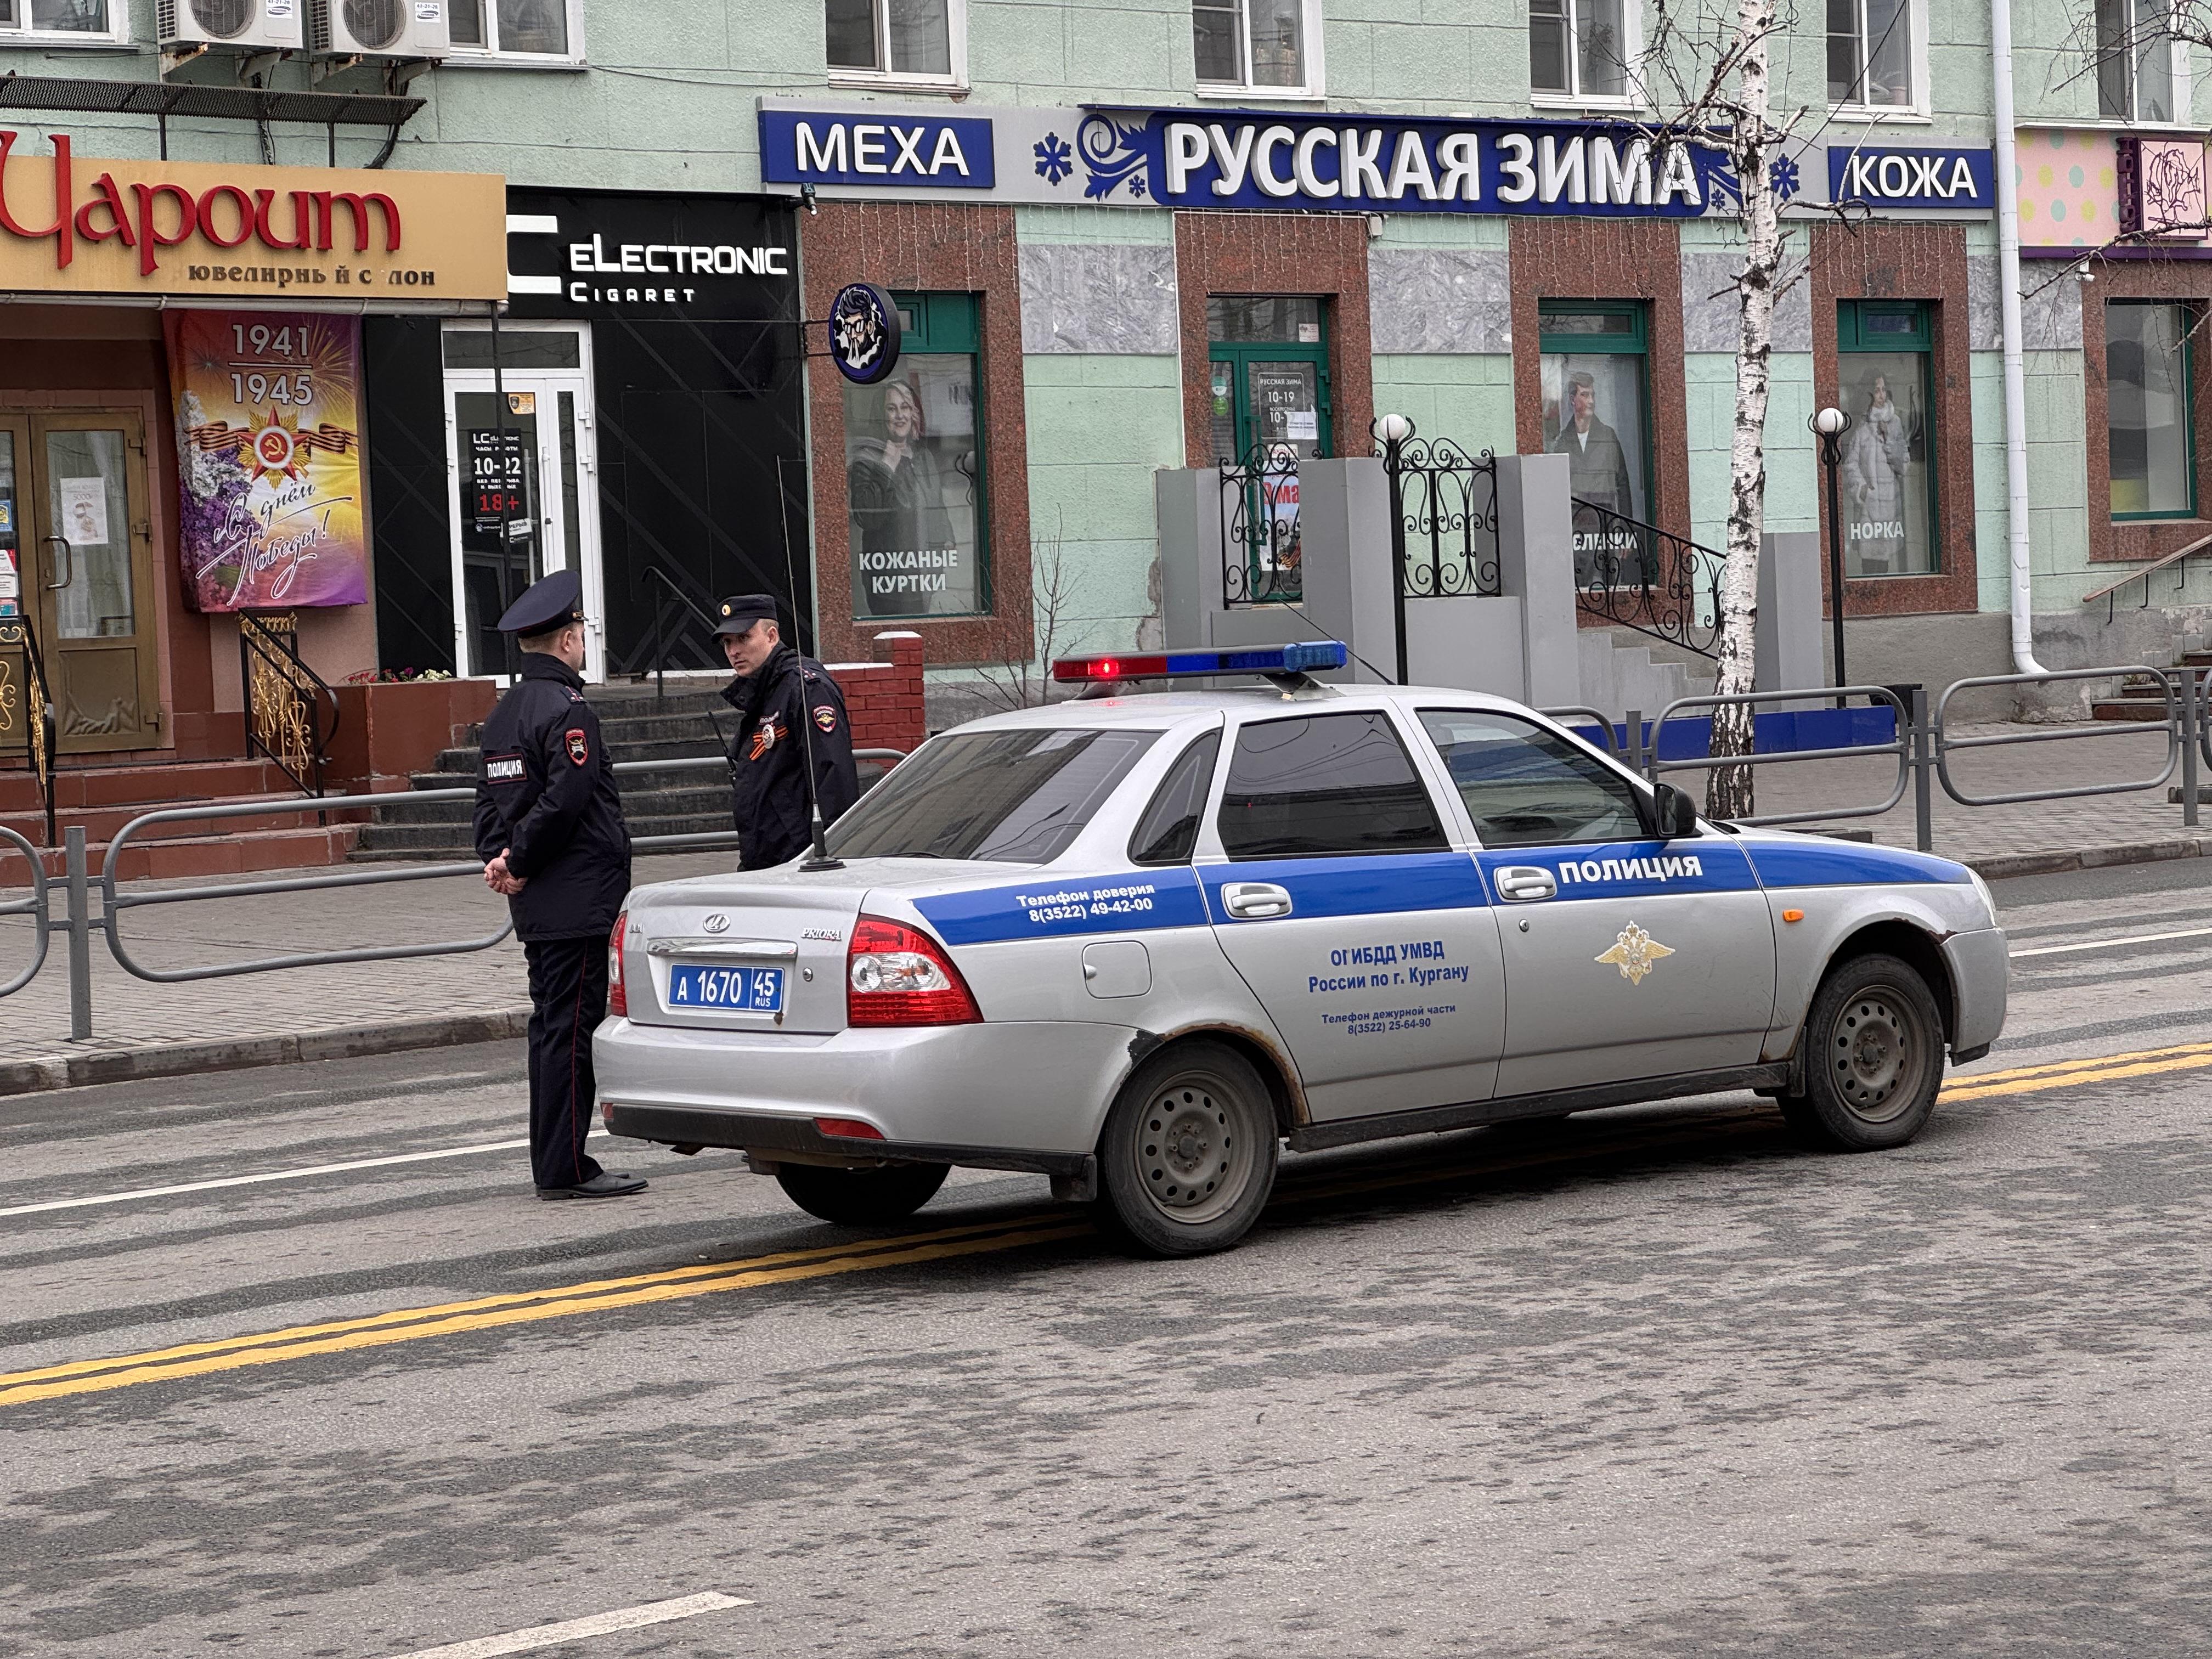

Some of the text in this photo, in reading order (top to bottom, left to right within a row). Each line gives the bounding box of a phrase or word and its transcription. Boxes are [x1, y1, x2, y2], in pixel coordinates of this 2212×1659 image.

[796, 122, 969, 176] МЕХА
[1164, 123, 1702, 206] РУССКАЯ ЗИМА
[1853, 155, 1977, 198] КОЖА
[232, 324, 308, 357] 1941
[231, 373, 313, 405] 1945
[1268, 391, 1295, 403] 10-19
[474, 457, 521, 475] 10-22
[479, 494, 519, 511] 18+
[1850, 521, 1904, 539] НОРКА
[859, 550, 957, 570] КОЖАНЫЕ
[872, 574, 946, 594] КУРТКИ
[487, 759, 523, 778] ПОЛИЦИЯ
[1559, 856, 1703, 883] ПОЛИЦИЯ
[1016, 884, 1155, 907] Телефон доверия
[1029, 898, 1153, 923] 8(3522) 49-42-00
[800, 928, 842, 941] PRIORA
[1330, 940, 1444, 966] ОГИБДД УМВД
[697, 971, 742, 1003] 1670
[754, 972, 775, 996] 45
[1308, 966, 1469, 992] России по г. Кургану
[755, 997, 770, 1007] RUS
[1322, 1005, 1455, 1024] Телефон дежурной части
[1347, 1018, 1431, 1036] 8(3522) 25-64-90
